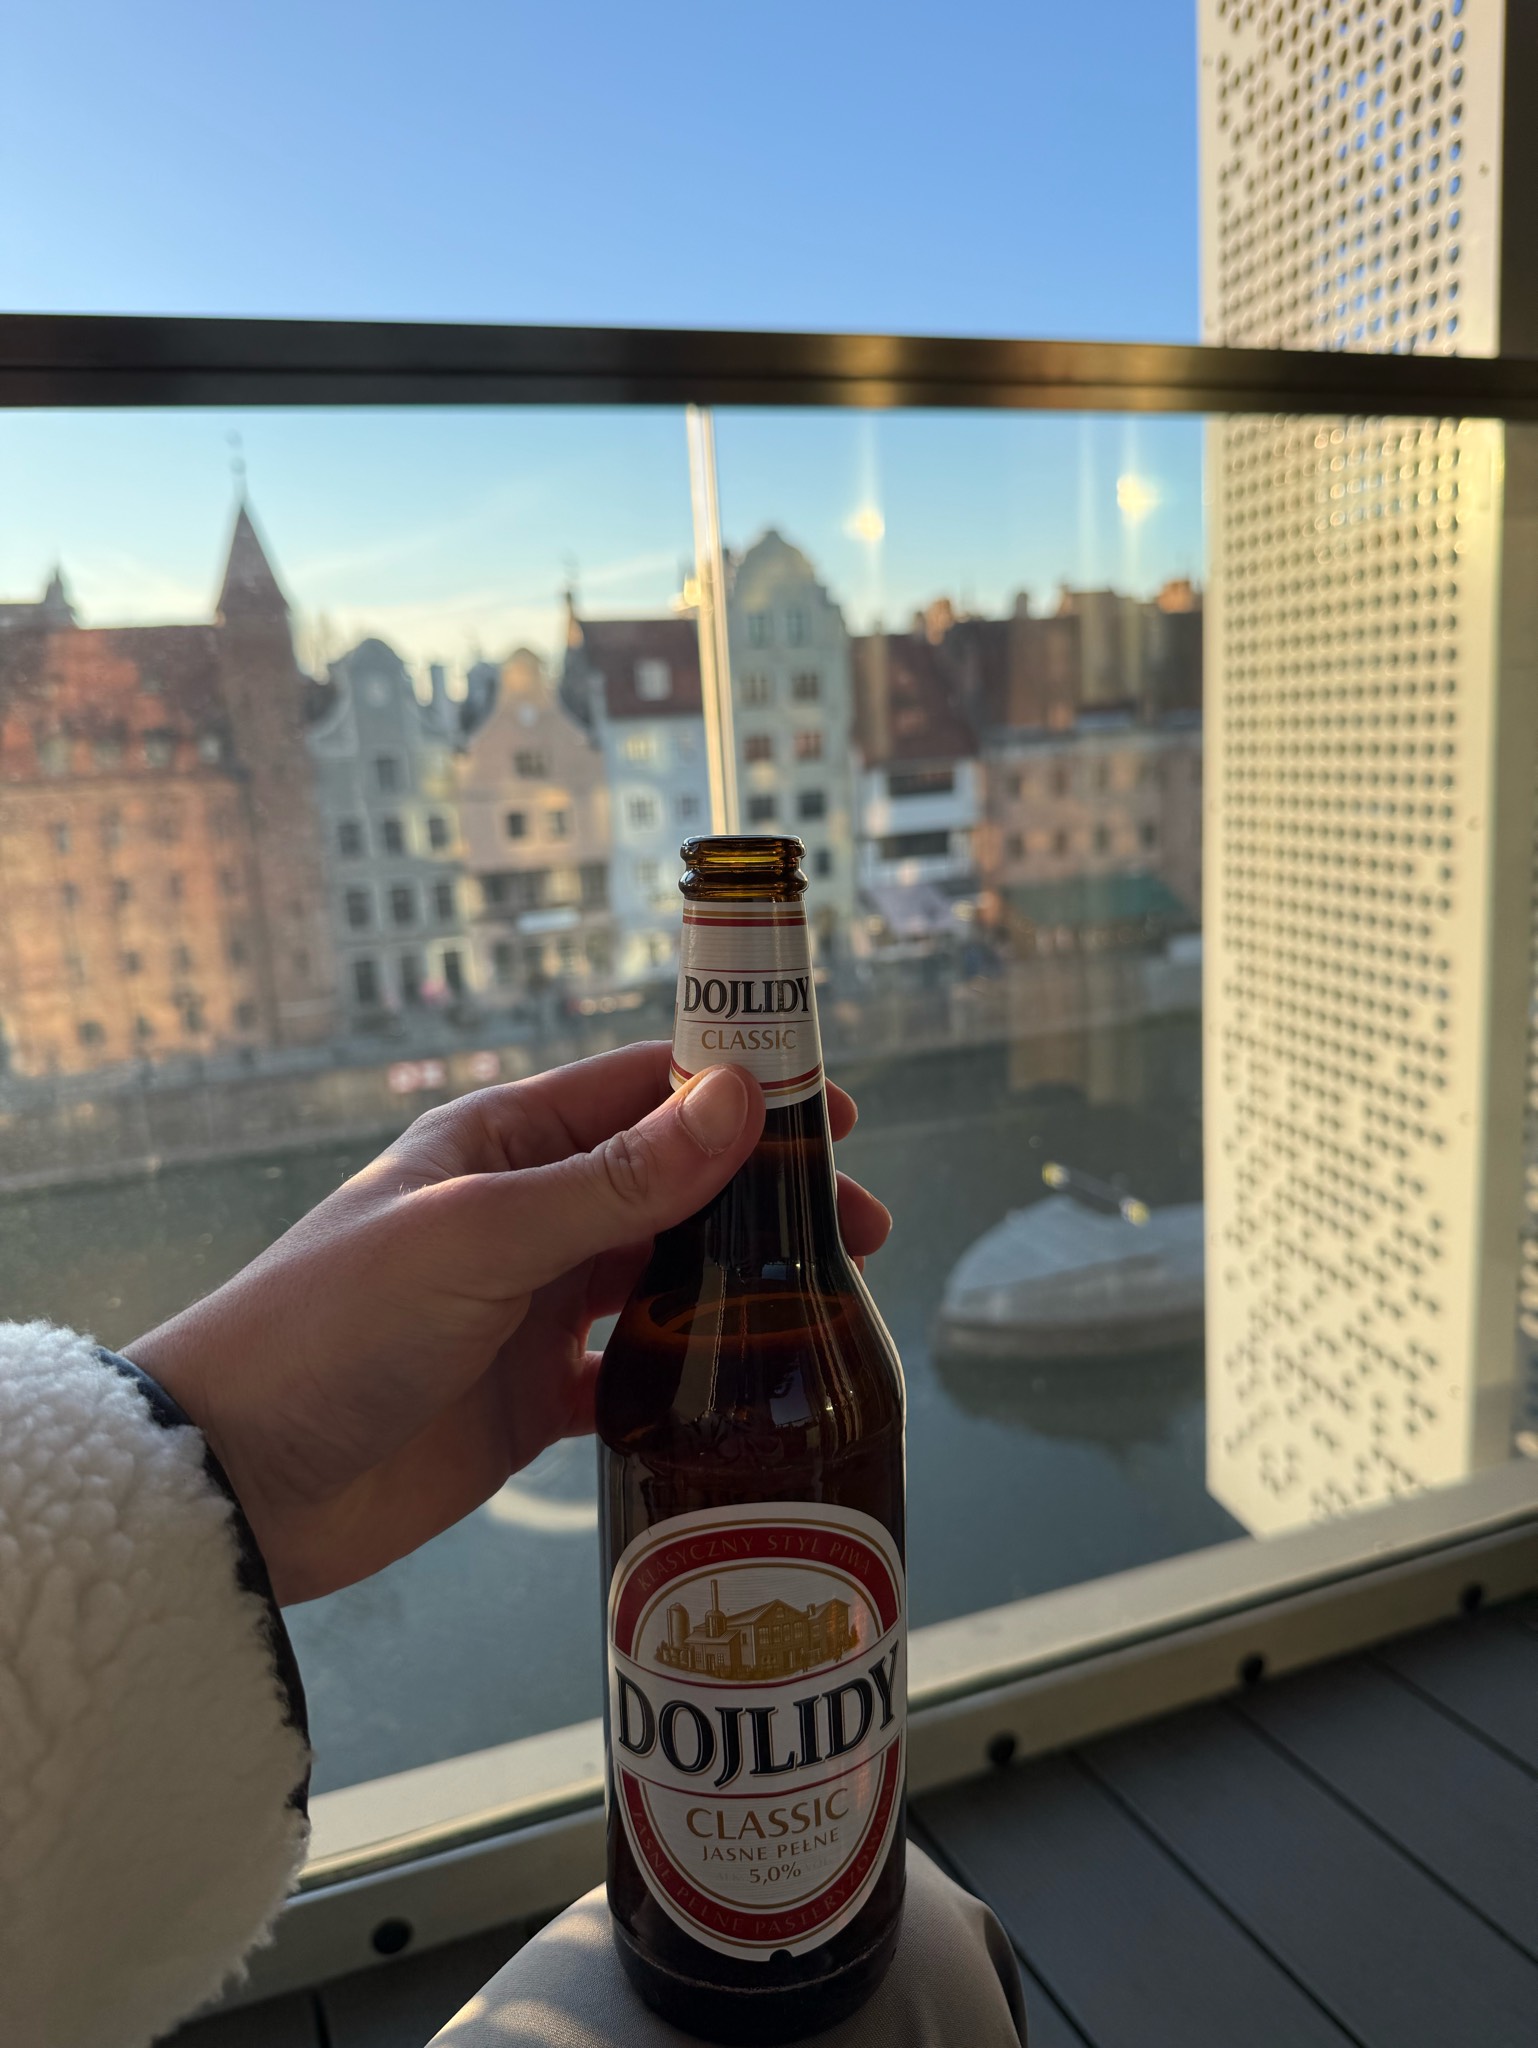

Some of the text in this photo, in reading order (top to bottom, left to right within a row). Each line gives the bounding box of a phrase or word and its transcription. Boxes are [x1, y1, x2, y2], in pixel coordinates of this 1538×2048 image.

[683, 975, 810, 1020] DOJLIDY
[701, 1029, 797, 1050] CLASSIC
[637, 1535, 872, 1591] KLASYCZNY STYL PIWA
[614, 1640, 900, 1789] DOJLIDY
[686, 1787, 850, 1840] CLASSIC
[632, 1811, 672, 1882] JASNE
[702, 1826, 840, 1862] JASNE PEŁNE
[749, 1861, 802, 1886] 5,0%
